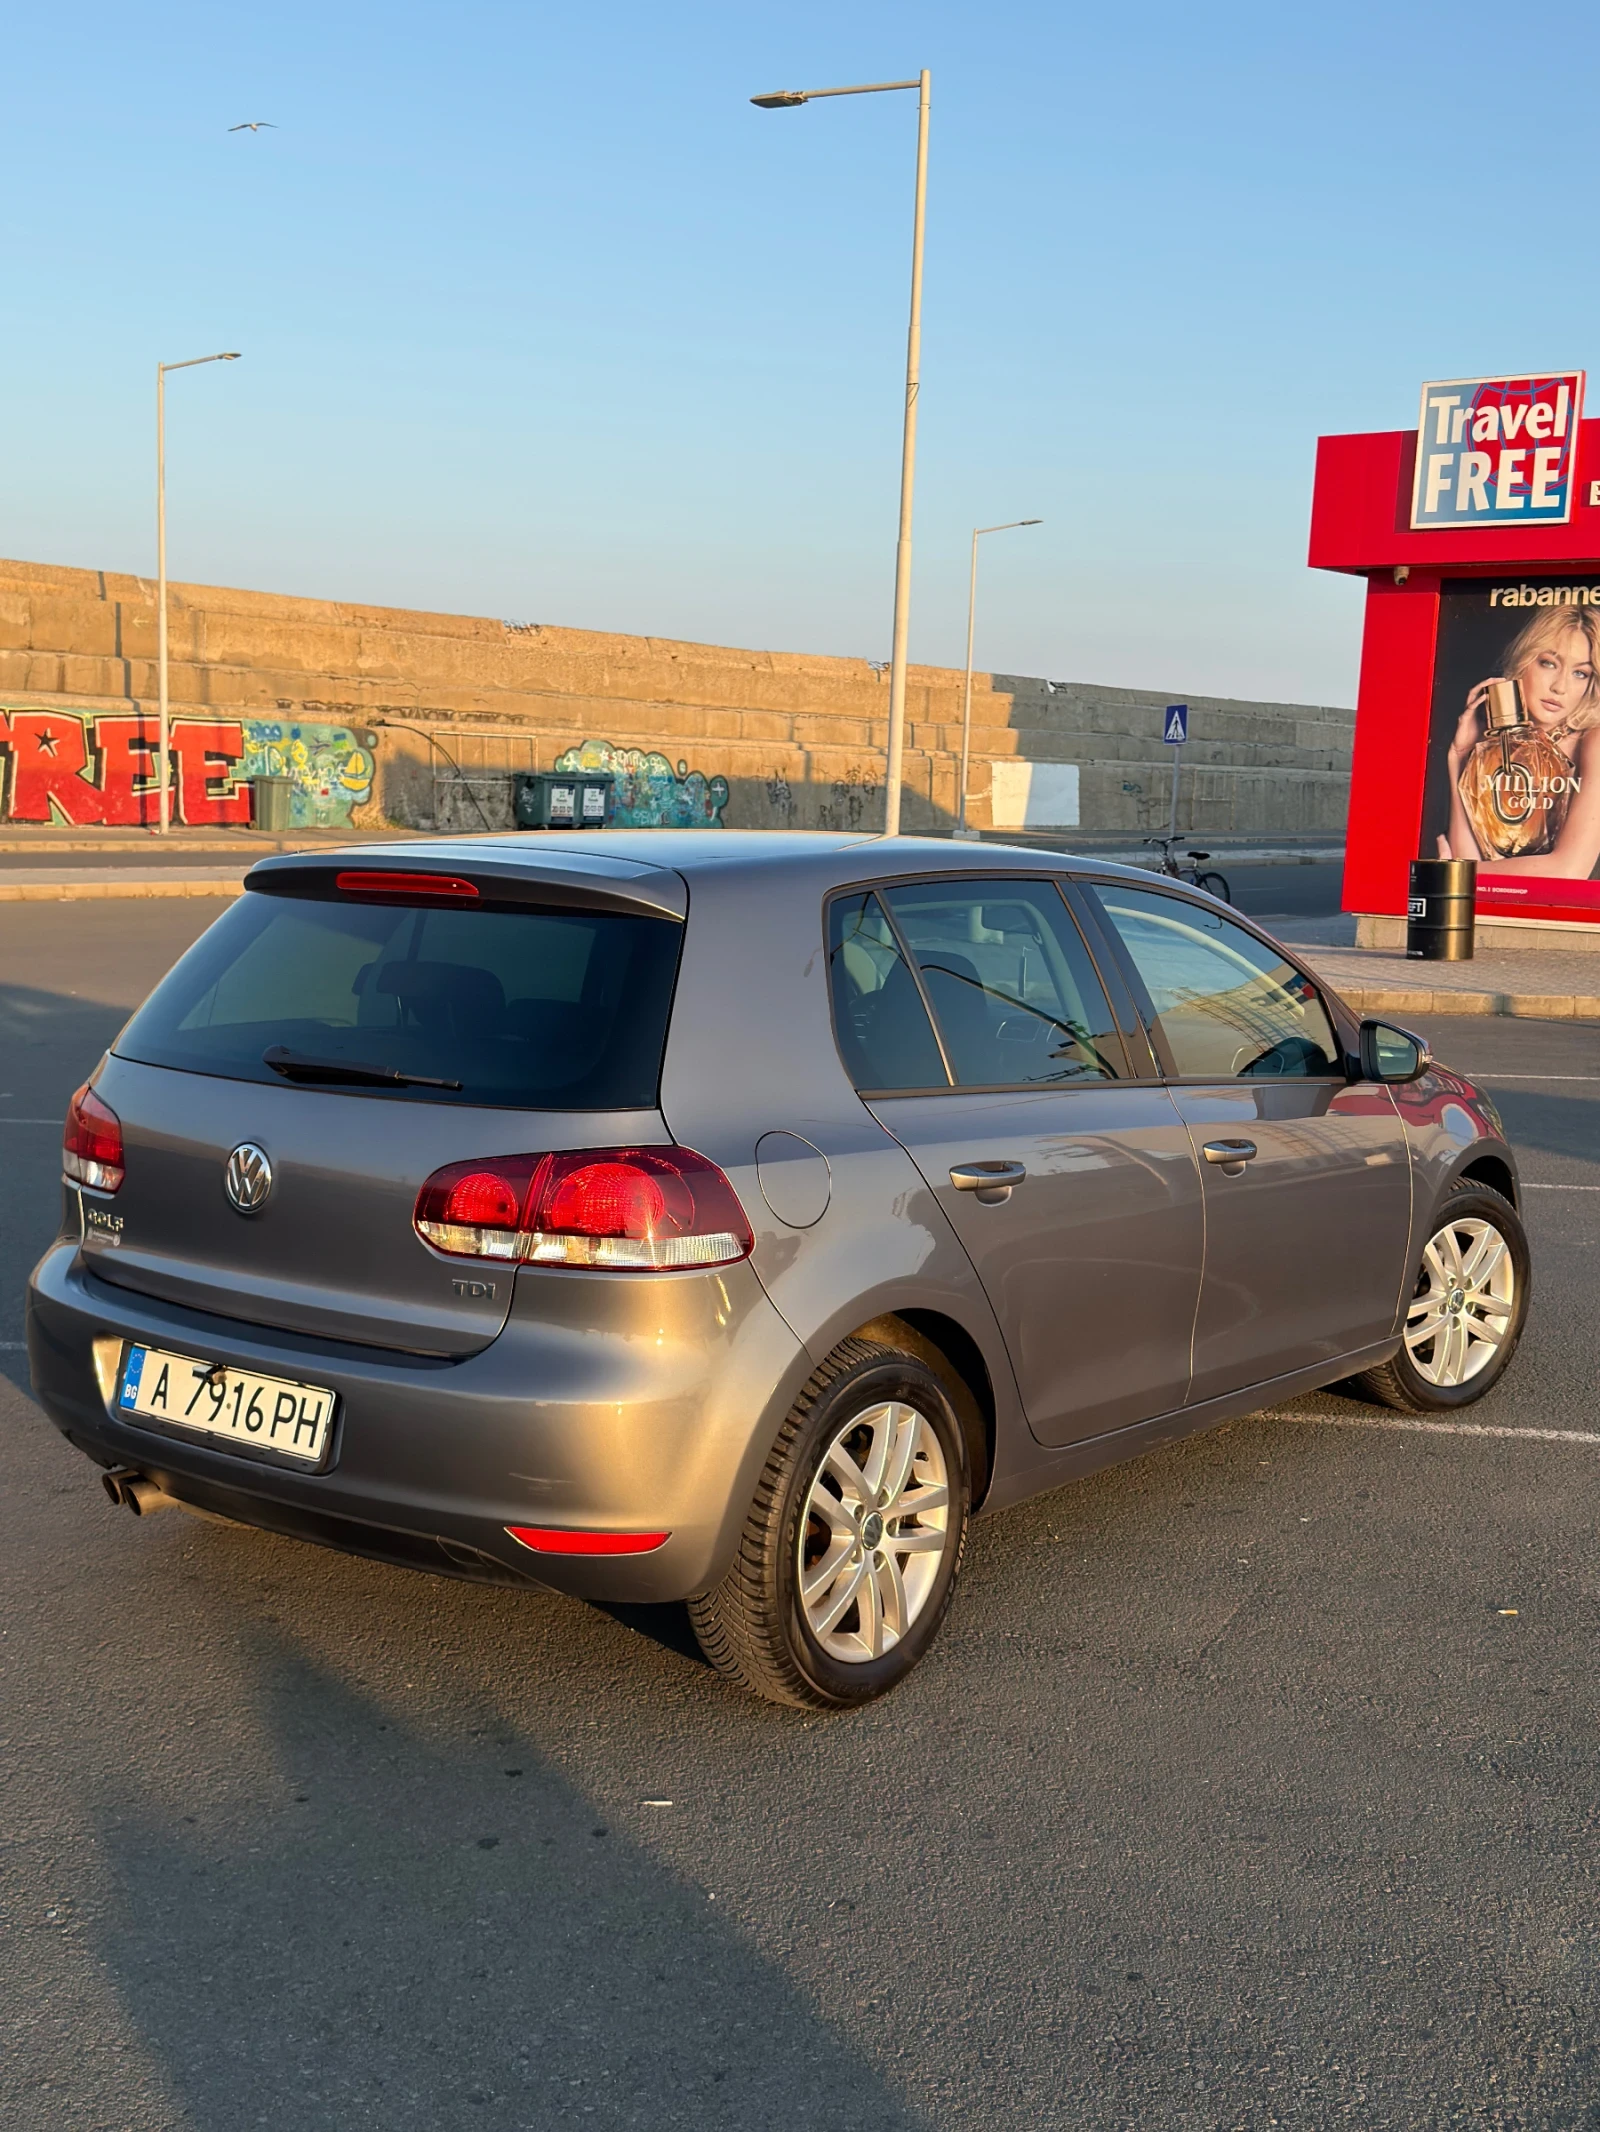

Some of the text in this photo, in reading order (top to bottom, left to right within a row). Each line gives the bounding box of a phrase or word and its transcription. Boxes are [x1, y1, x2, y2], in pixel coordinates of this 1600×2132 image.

[1428, 385, 1570, 444] Travel
[1424, 446, 1562, 513] FREE
[1489, 583, 1600, 607] rabanne
[1482, 774, 1583, 794] MILLION
[1507, 796, 1554, 810] GOLD
[452, 1279, 496, 1300] TDI
[124, 1383, 138, 1400] BG
[150, 1363, 323, 1449] A 7916 PH
